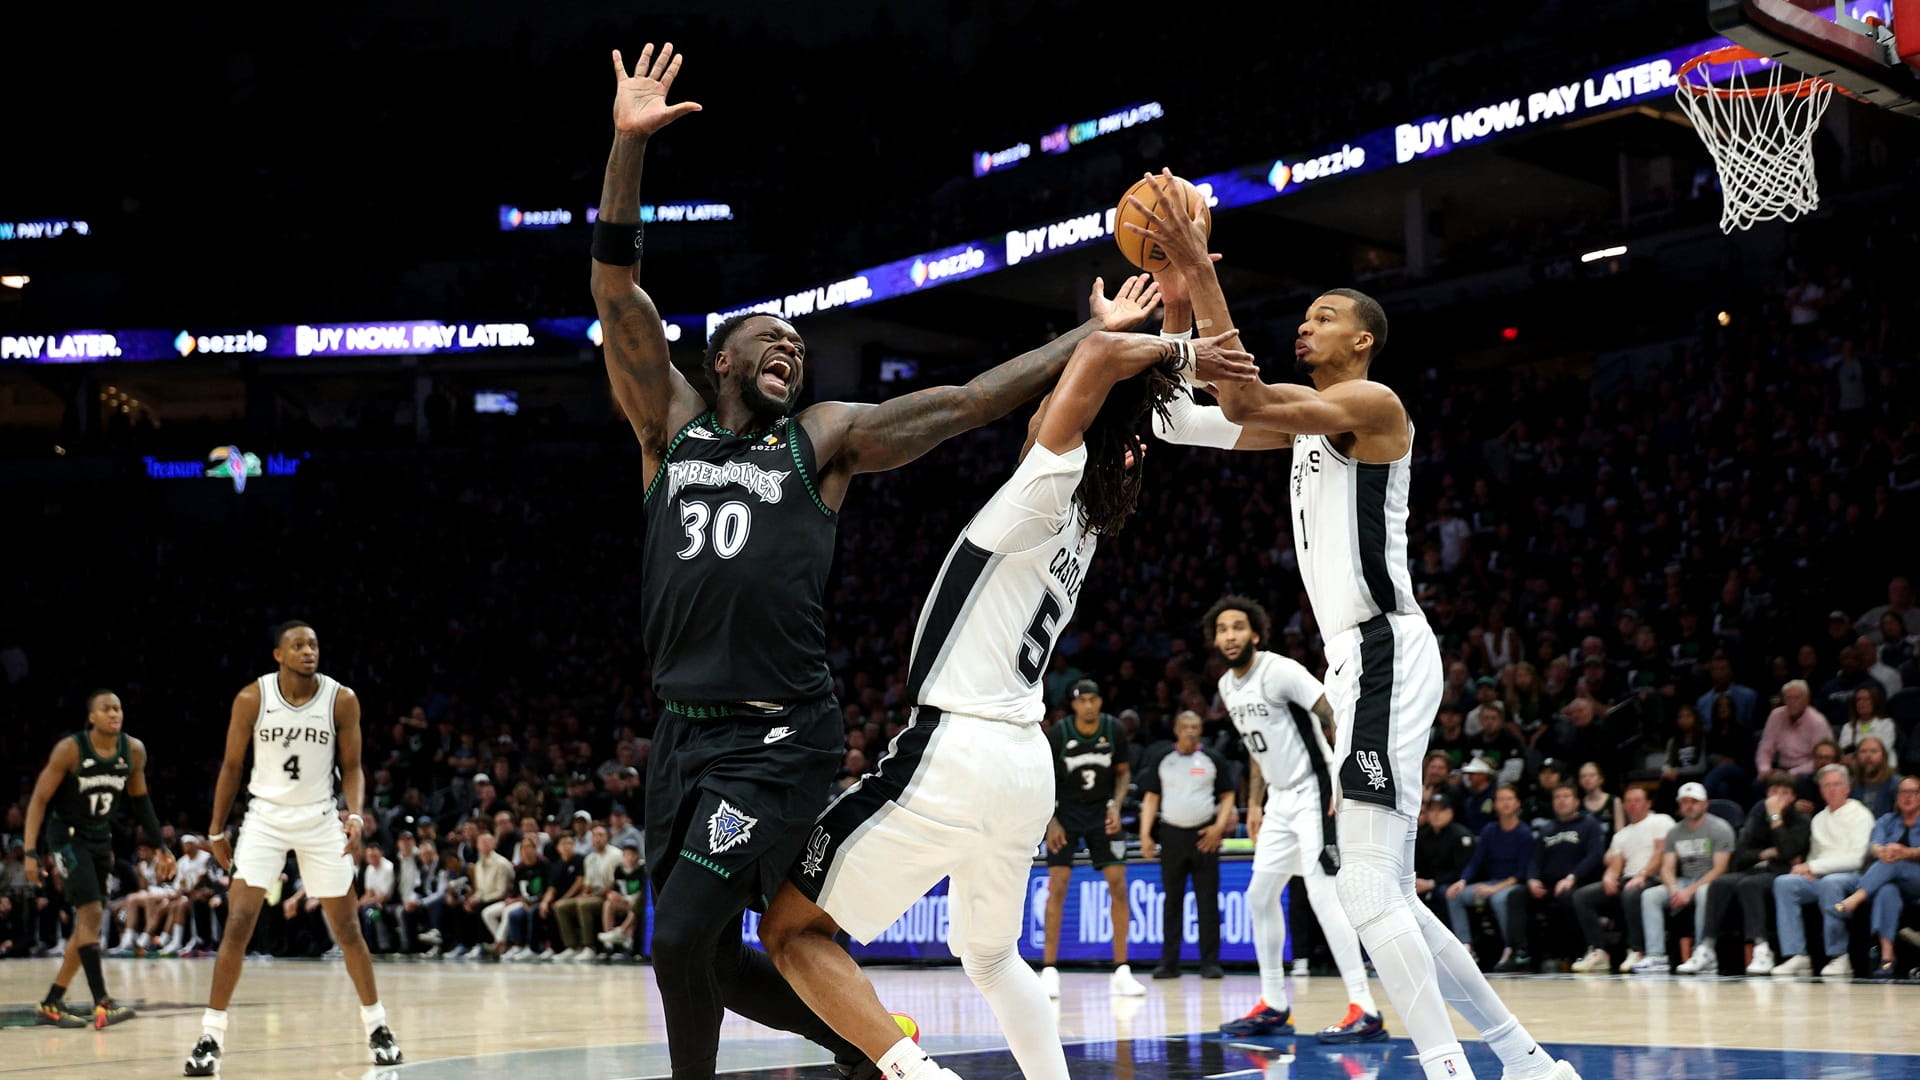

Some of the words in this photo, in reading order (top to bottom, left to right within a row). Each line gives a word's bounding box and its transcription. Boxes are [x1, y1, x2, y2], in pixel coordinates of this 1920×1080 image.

[1396, 116, 1449, 164] BUY
[1451, 98, 1525, 144] NOW.
[1528, 84, 1582, 123] PAY
[1584, 59, 1679, 108] LATER.
[1291, 144, 1365, 184] sezzle
[658, 205, 685, 222] PAY
[685, 204, 734, 221] LATER.
[17, 222, 45, 239] PAY
[1006, 228, 1047, 266] BUY
[1048, 212, 1104, 249] NOW.
[927, 246, 985, 280] sezzle
[785, 288, 817, 319] PAY
[815, 276, 873, 310] LATER.
[1, 336, 44, 359] PAY
[47, 334, 122, 357] LATER.
[197, 330, 267, 353] sezzle
[296, 325, 344, 356] BUY
[346, 326, 409, 350] NOW.
[413, 325, 456, 348] PAY
[459, 323, 535, 347] LATER.
[693, 426, 715, 438] NIKE
[751, 442, 787, 451] sezzle
[143, 455, 205, 479] Treasure
[677, 499, 751, 559] 30
[1015, 586, 1064, 689] 5
[259, 727, 330, 748] SPURS
[283, 754, 301, 780] 4
[1081, 770, 1096, 790] 3
[88, 792, 114, 816] 13
